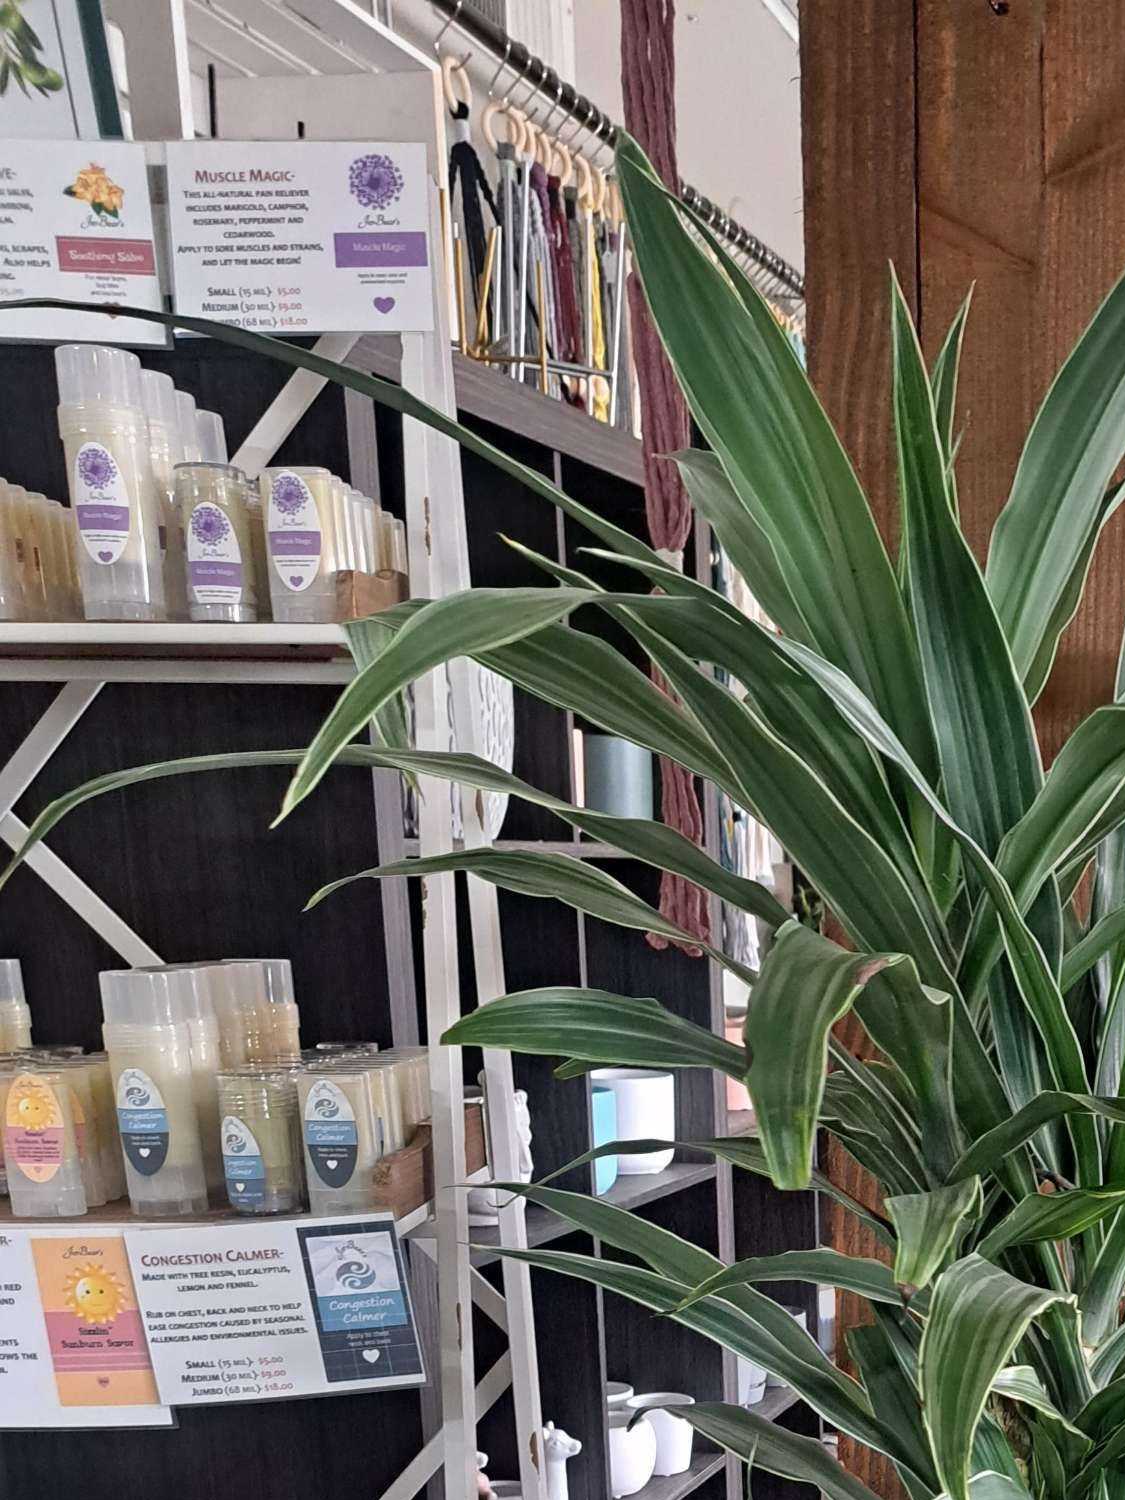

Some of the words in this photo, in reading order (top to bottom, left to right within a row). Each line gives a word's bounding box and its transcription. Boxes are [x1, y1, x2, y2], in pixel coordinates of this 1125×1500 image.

[195, 170, 246, 182] MUSCLE
[250, 169, 296, 182] MAGIC-
[184, 190, 201, 198] THIS
[203, 190, 253, 198] ALL-NATURAL
[256, 190, 273, 198] PAIN
[186, 203, 222, 212] INCLUDES
[224, 203, 267, 212] MARIGOLD,
[268, 203, 309, 212] CAMPHOR,
[193, 217, 237, 226] ROSEMARY,
[239, 217, 285, 225] PEPPERMINT
[12, 246, 48, 254] SCRAPES,
[178, 245, 202, 253] APPLY
[215, 244, 234, 252] SORE
[236, 244, 270, 252] MUSCLES
[290, 244, 324, 252] STRAINS,
[3, 258, 25, 267] ALSO
[27, 259, 51, 267] HELPS
[202, 258, 218, 266] AND
[220, 258, 232, 266] LET
[208, 287, 236, 296] SMALL
[202, 303, 238, 312] MEDIUM
[242, 317, 258, 327] (68
[141, 1252, 223, 1267] CONGESTION
[226, 1249, 284, 1262] CALMER-
[142, 1272, 166, 1281] MADE
[168, 1271, 188, 1280] WITH
[190, 1270, 209, 1279] TREE
[210, 1270, 236, 1278] RESIN,
[237, 1266, 291, 1276] EUCALYPTUS,
[177, 1284, 206, 1292] LEMON
[226, 1281, 259, 1290] FENNEL.
[329, 1295, 395, 1312] Congestion
[146, 1310, 163, 1318] RUB
[165, 1310, 176, 1318] ON
[178, 1308, 205, 1317] CHEST,
[207, 1307, 227, 1316] BACK
[229, 1306, 246, 1314] AND
[247, 1305, 268, 1313] NECK
[282, 1302, 302, 1311] HELP
[343, 1311, 386, 1324] Calmer
[149, 1323, 167, 1331] EASE
[168, 1320, 218, 1330] CONGESTION
[219, 1319, 250, 1328] CAUSED
[263, 1315, 306, 1324] SEASONAL
[151, 1334, 190, 1343] ALLERGIES
[192, 1332, 208, 1341] AND
[210, 1329, 277, 1340] ENVIRONMENTAL
[279, 1327, 308, 1335] ISSUES.
[62, 1340, 103, 1348] Sunburn
[185, 1360, 216, 1369] SMALL
[182, 1374, 220, 1383] MEDIUM
[192, 1387, 223, 1397] JUMBO
[225, 1386, 240, 1396] (68
[264, 1382, 293, 1393] $18.00
